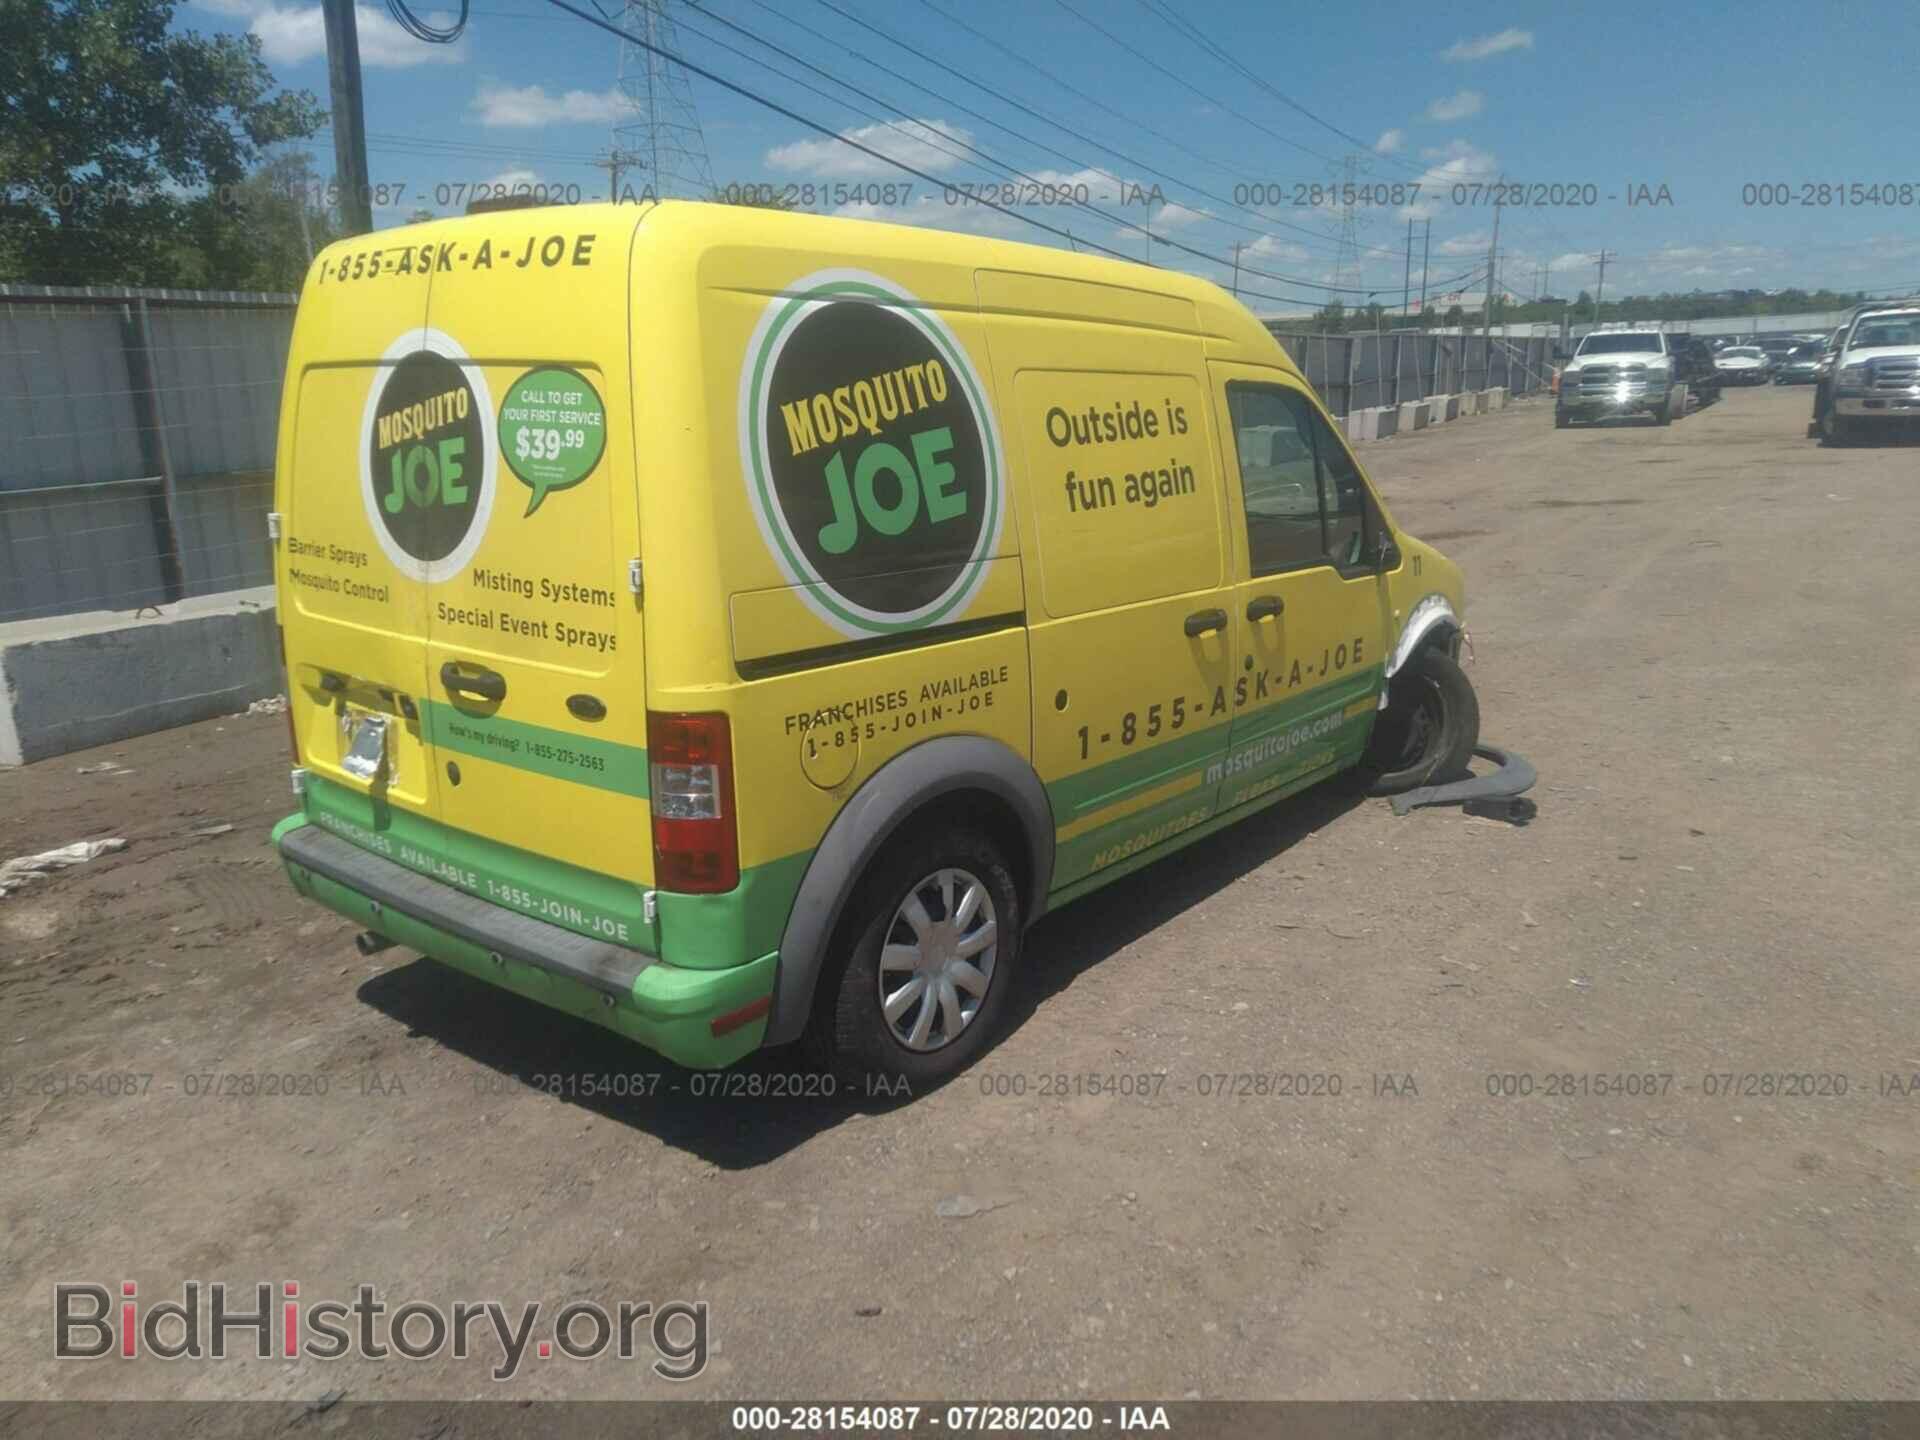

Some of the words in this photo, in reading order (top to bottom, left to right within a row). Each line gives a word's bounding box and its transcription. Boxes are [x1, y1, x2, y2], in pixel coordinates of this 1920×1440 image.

[319, 234, 596, 285] 1-855-ASK-A-JOE
[378, 386, 468, 450] MOSQUITO
[504, 407, 529, 421] YOUR
[531, 409, 557, 423] FIRST
[559, 411, 601, 426] SERVICE
[521, 390, 545, 404] CALL
[548, 391, 561, 404] TO
[563, 392, 583, 405] GET
[780, 359, 947, 457] MOSQUITO
[1046, 400, 1159, 447] Outside
[1164, 398, 1188, 436] is
[516, 425, 585, 462] $39.99
[384, 437, 468, 514] JOE
[818, 426, 967, 554] JOE
[1065, 470, 1116, 512] fun
[1124, 458, 1196, 508] again
[288, 537, 326, 559] Barrier
[329, 546, 368, 567] Sprays
[289, 568, 340, 594] Mosquito
[344, 579, 389, 603] Control
[473, 568, 533, 599] Misting
[541, 577, 615, 608] Systems
[438, 602, 494, 629] Special
[500, 613, 548, 640] Event
[555, 622, 616, 651] Sprays
[784, 690, 908, 735] FRANCHISES
[919, 666, 1009, 703] AVAILABLE
[807, 691, 993, 758] 1-855-JOIN-JOE
[1077, 637, 1363, 760] 1-855-ASK-A-JOE
[1206, 710, 1343, 785] mosquitojoe.com
[400, 845, 478, 889] AVAILABLE
[487, 879, 630, 942] 1-855-JOIN-JOE
